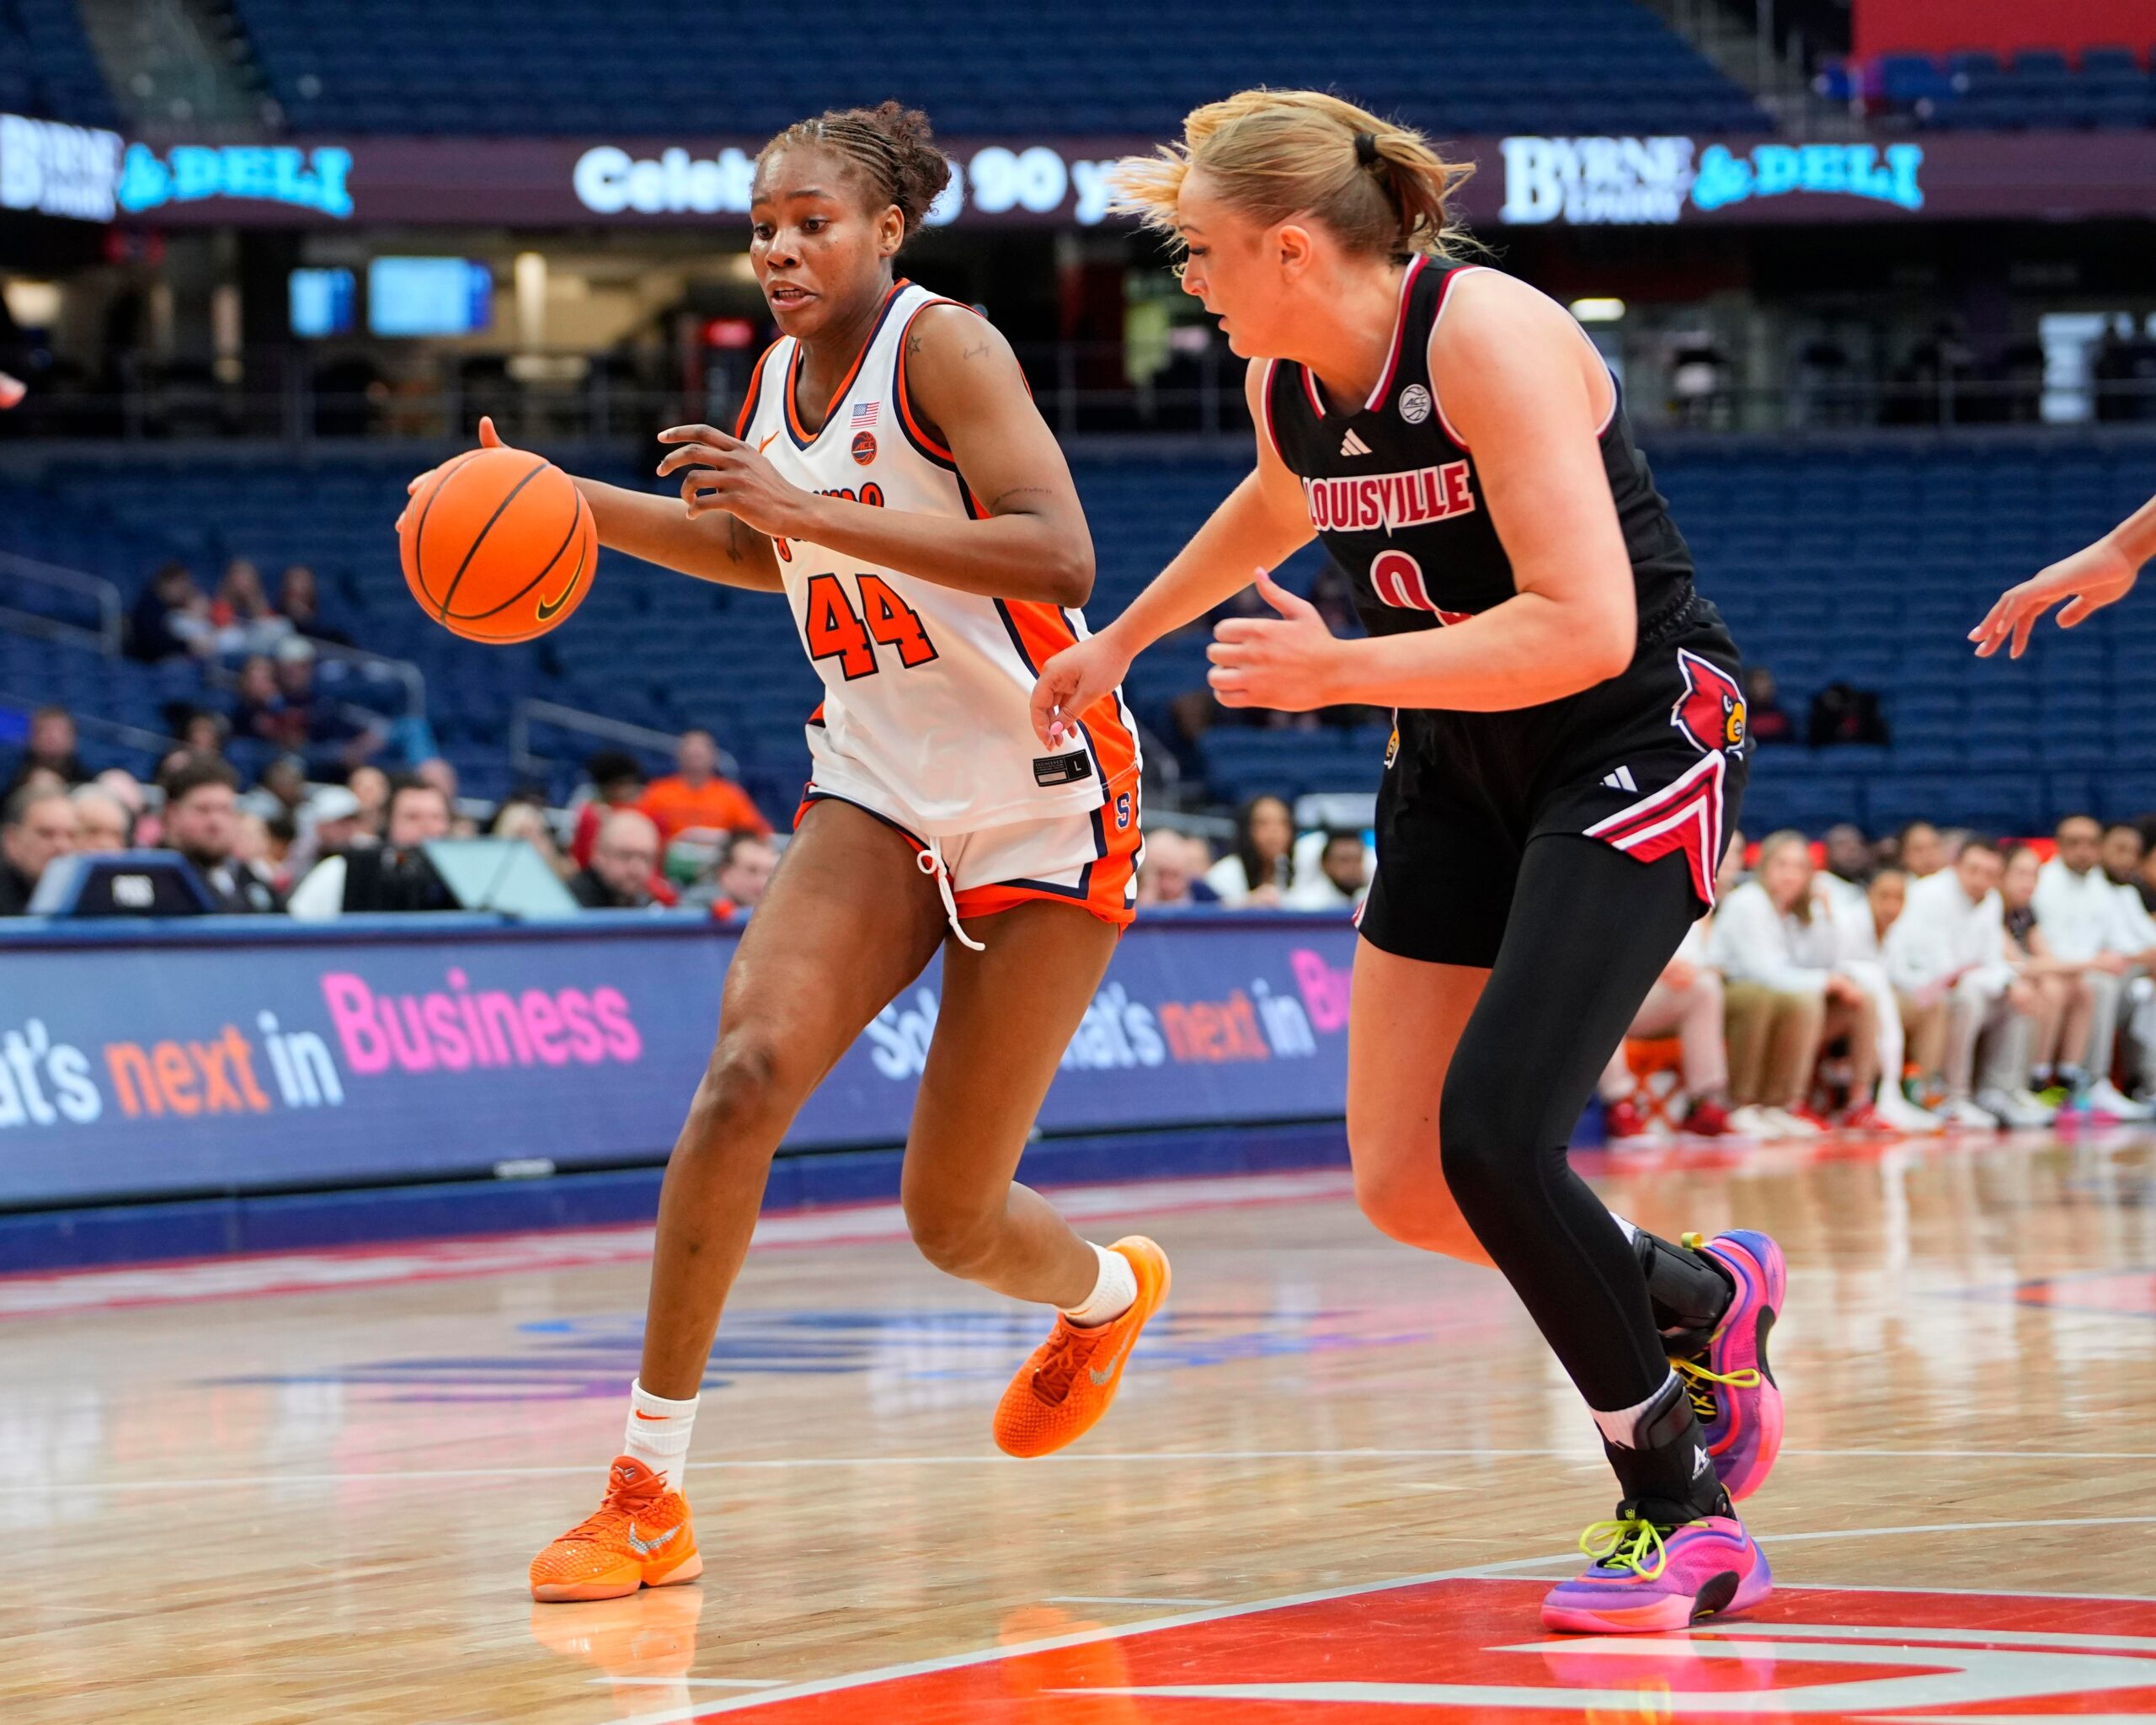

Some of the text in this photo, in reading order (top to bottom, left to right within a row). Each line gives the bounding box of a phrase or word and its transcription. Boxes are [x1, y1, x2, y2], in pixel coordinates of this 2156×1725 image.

[169, 147, 352, 216] DELI
[969, 146, 1067, 212] 90
[1751, 144, 1924, 210] DELI
[1303, 459, 1476, 537] LOUISVILLE
[805, 573, 939, 681] 44
[1073, 761, 1082, 772] L
[1116, 791, 1131, 829] S
[104, 1023, 271, 1119] next
[256, 1009, 345, 1108] in
[320, 966, 643, 1076] Business
[1160, 988, 1270, 1064] next
[1251, 977, 1317, 1058] in
